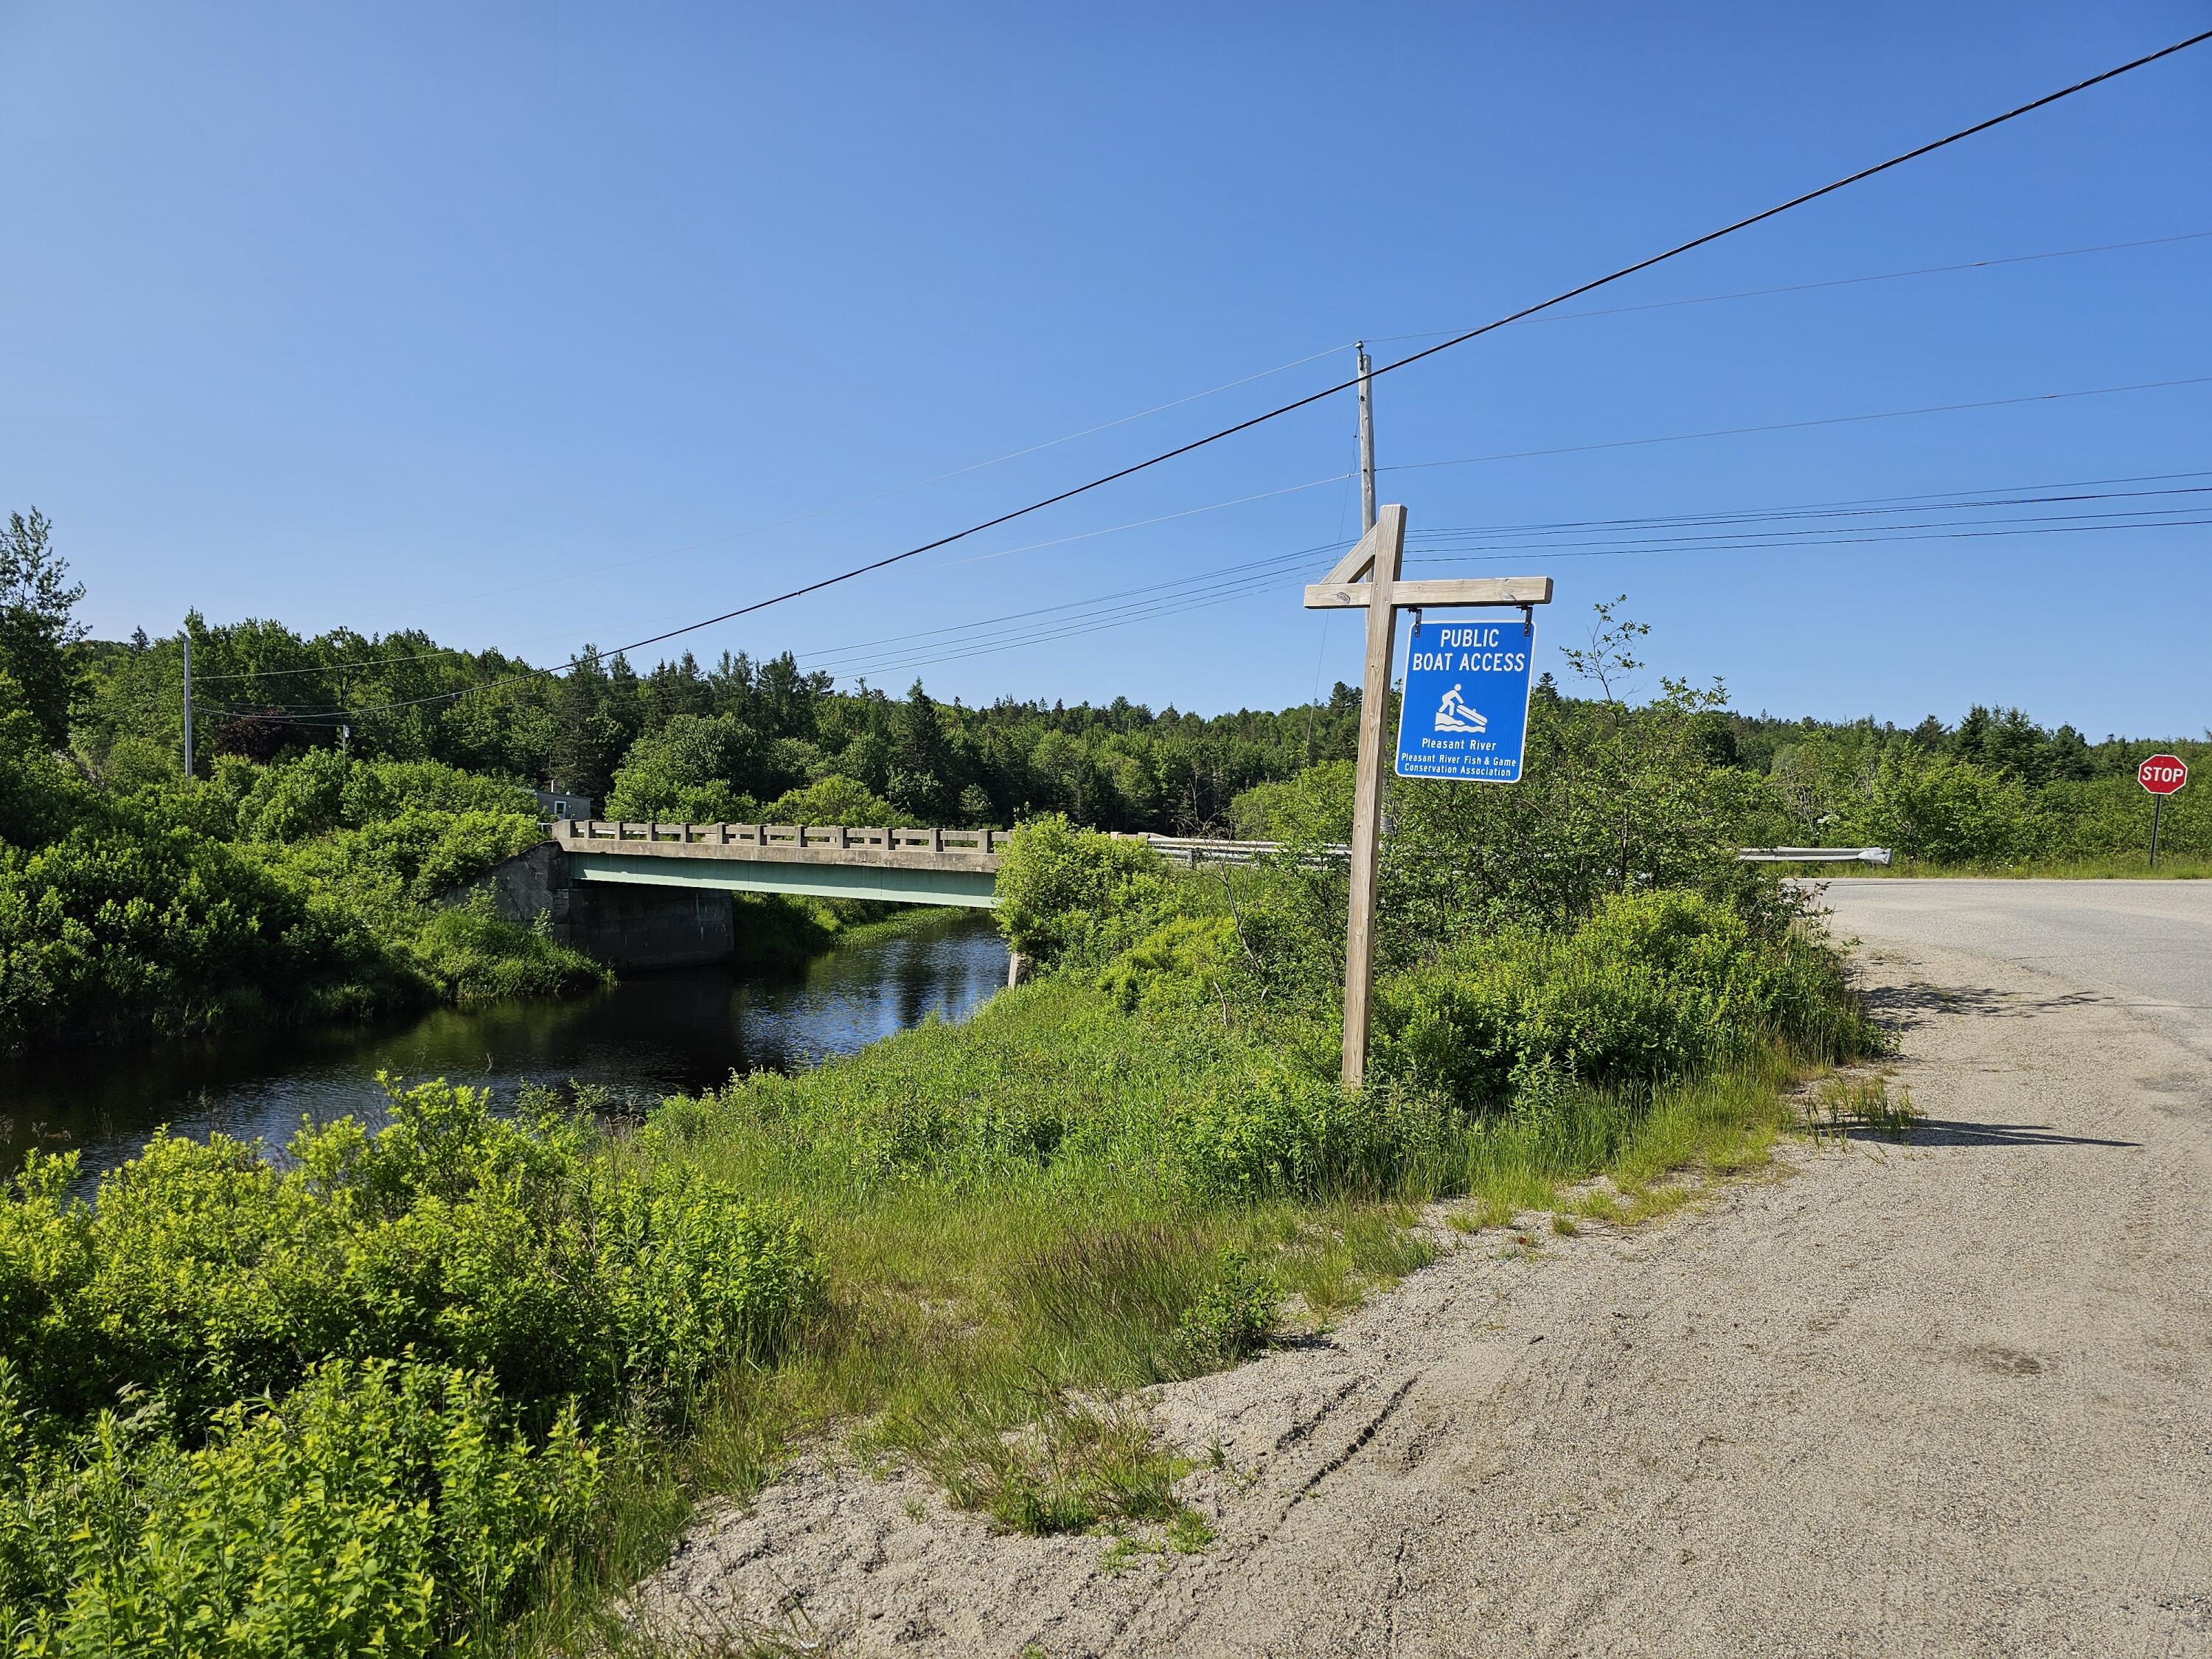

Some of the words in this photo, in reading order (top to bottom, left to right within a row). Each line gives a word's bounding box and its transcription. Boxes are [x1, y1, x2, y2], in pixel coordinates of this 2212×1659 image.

[1440, 629, 1500, 647] PUBLIC
[1413, 653, 1453, 671] BOAT
[1459, 653, 1526, 672] ACCESS
[1422, 737, 1464, 750] Pleasant
[1470, 740, 1497, 751] River
[1402, 753, 1436, 763] Pleasant
[1439, 754, 1461, 764] River
[1464, 756, 1481, 765] Fish
[1484, 757, 1490, 765] &
[1493, 757, 1517, 767] Game
[1405, 763, 1457, 774] Conservation
[1461, 765, 1511, 776] Association
[2141, 766, 2184, 782] STOP
